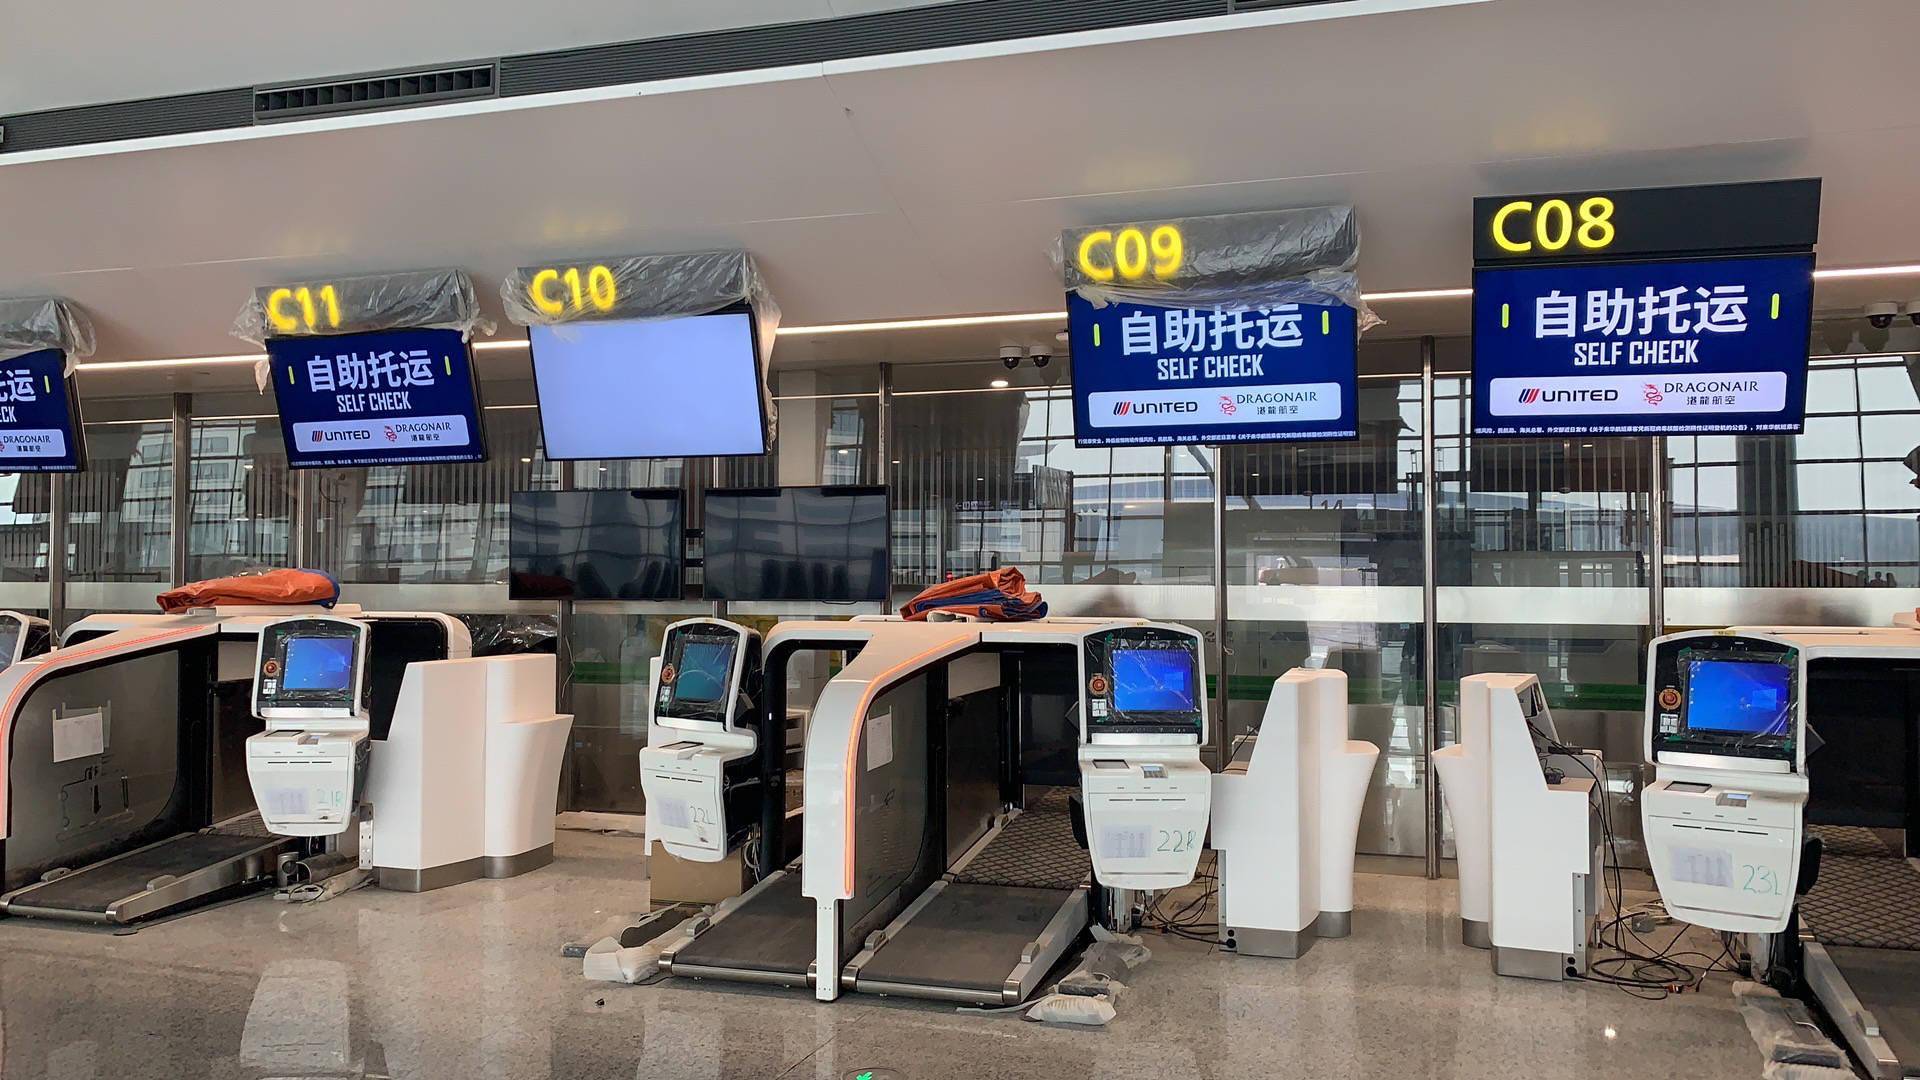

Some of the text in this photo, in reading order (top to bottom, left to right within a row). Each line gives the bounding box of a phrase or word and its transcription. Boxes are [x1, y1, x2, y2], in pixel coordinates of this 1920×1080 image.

[1492, 197, 1615, 252] C08
[1079, 225, 1184, 281] C09
[532, 265, 616, 315] C10
[268, 285, 341, 331] C11
[1535, 285, 1749, 339] 自助托运
[1121, 303, 1304, 356] 自助托运
[1574, 339, 1699, 366] SELF CHECK
[307, 349, 435, 392] 自助托运
[1157, 354, 1264, 380] SELF CHECK
[1236, 391, 1317, 404] DRAGONAIR
[1542, 389, 1619, 402] UNITED
[1664, 380, 1759, 393] DRAGONAIR
[336, 391, 412, 413] SELF CHECK
[1132, 401, 1198, 414] UNITED
[3, 435, 51, 443] DRAGONAIR
[325, 430, 370, 441] UNITED
[395, 422, 451, 433] DRAGONAIR
[1743, 864, 1782, 896] 23L
